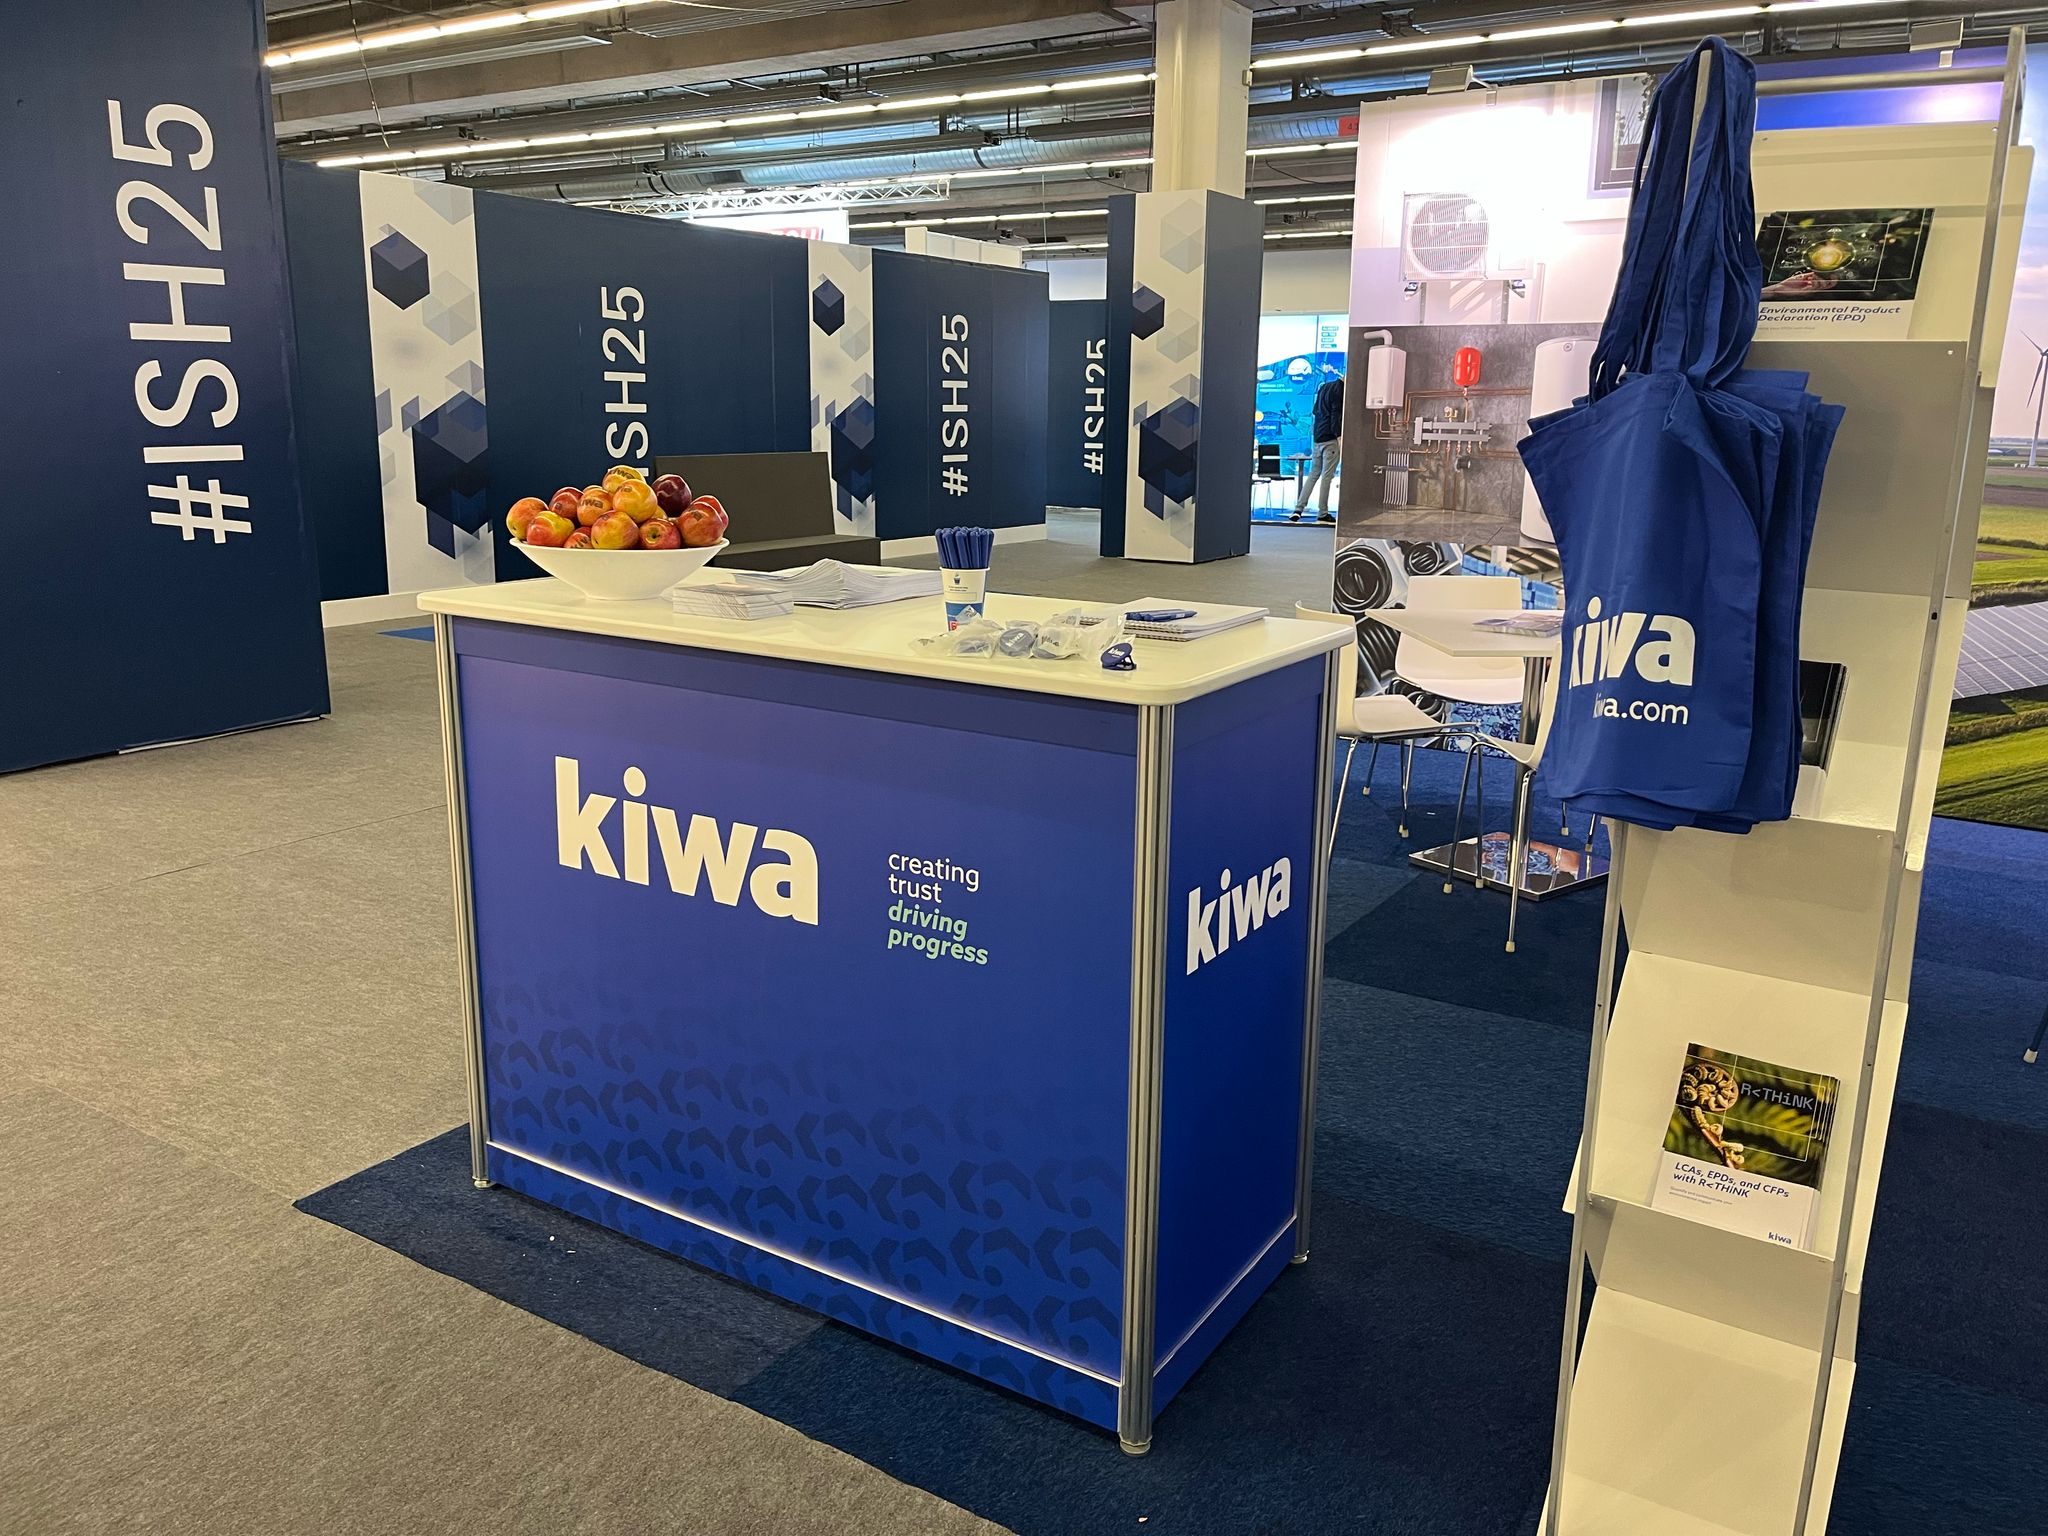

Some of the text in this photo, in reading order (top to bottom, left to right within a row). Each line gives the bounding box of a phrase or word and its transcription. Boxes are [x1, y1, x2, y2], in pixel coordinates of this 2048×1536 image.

[107, 99, 252, 544] #ISH25
[1757, 314, 1866, 323] Declaration (EPD)
[1759, 306, 1901, 314] Environmental Product
[942, 314, 968, 496] #ISH25
[555, 755, 819, 926] kiwa
[888, 853, 980, 892] creating
[888, 873, 942, 903] trust
[888, 900, 968, 941] driving
[1186, 857, 1291, 976] kiwa
[887, 928, 989, 965] progress
[1673, 1173, 1696, 1185] with
[1675, 1162, 1790, 1198] LCAs, EPDs, and CFPs
[1768, 1232, 1792, 1245] kiwa
